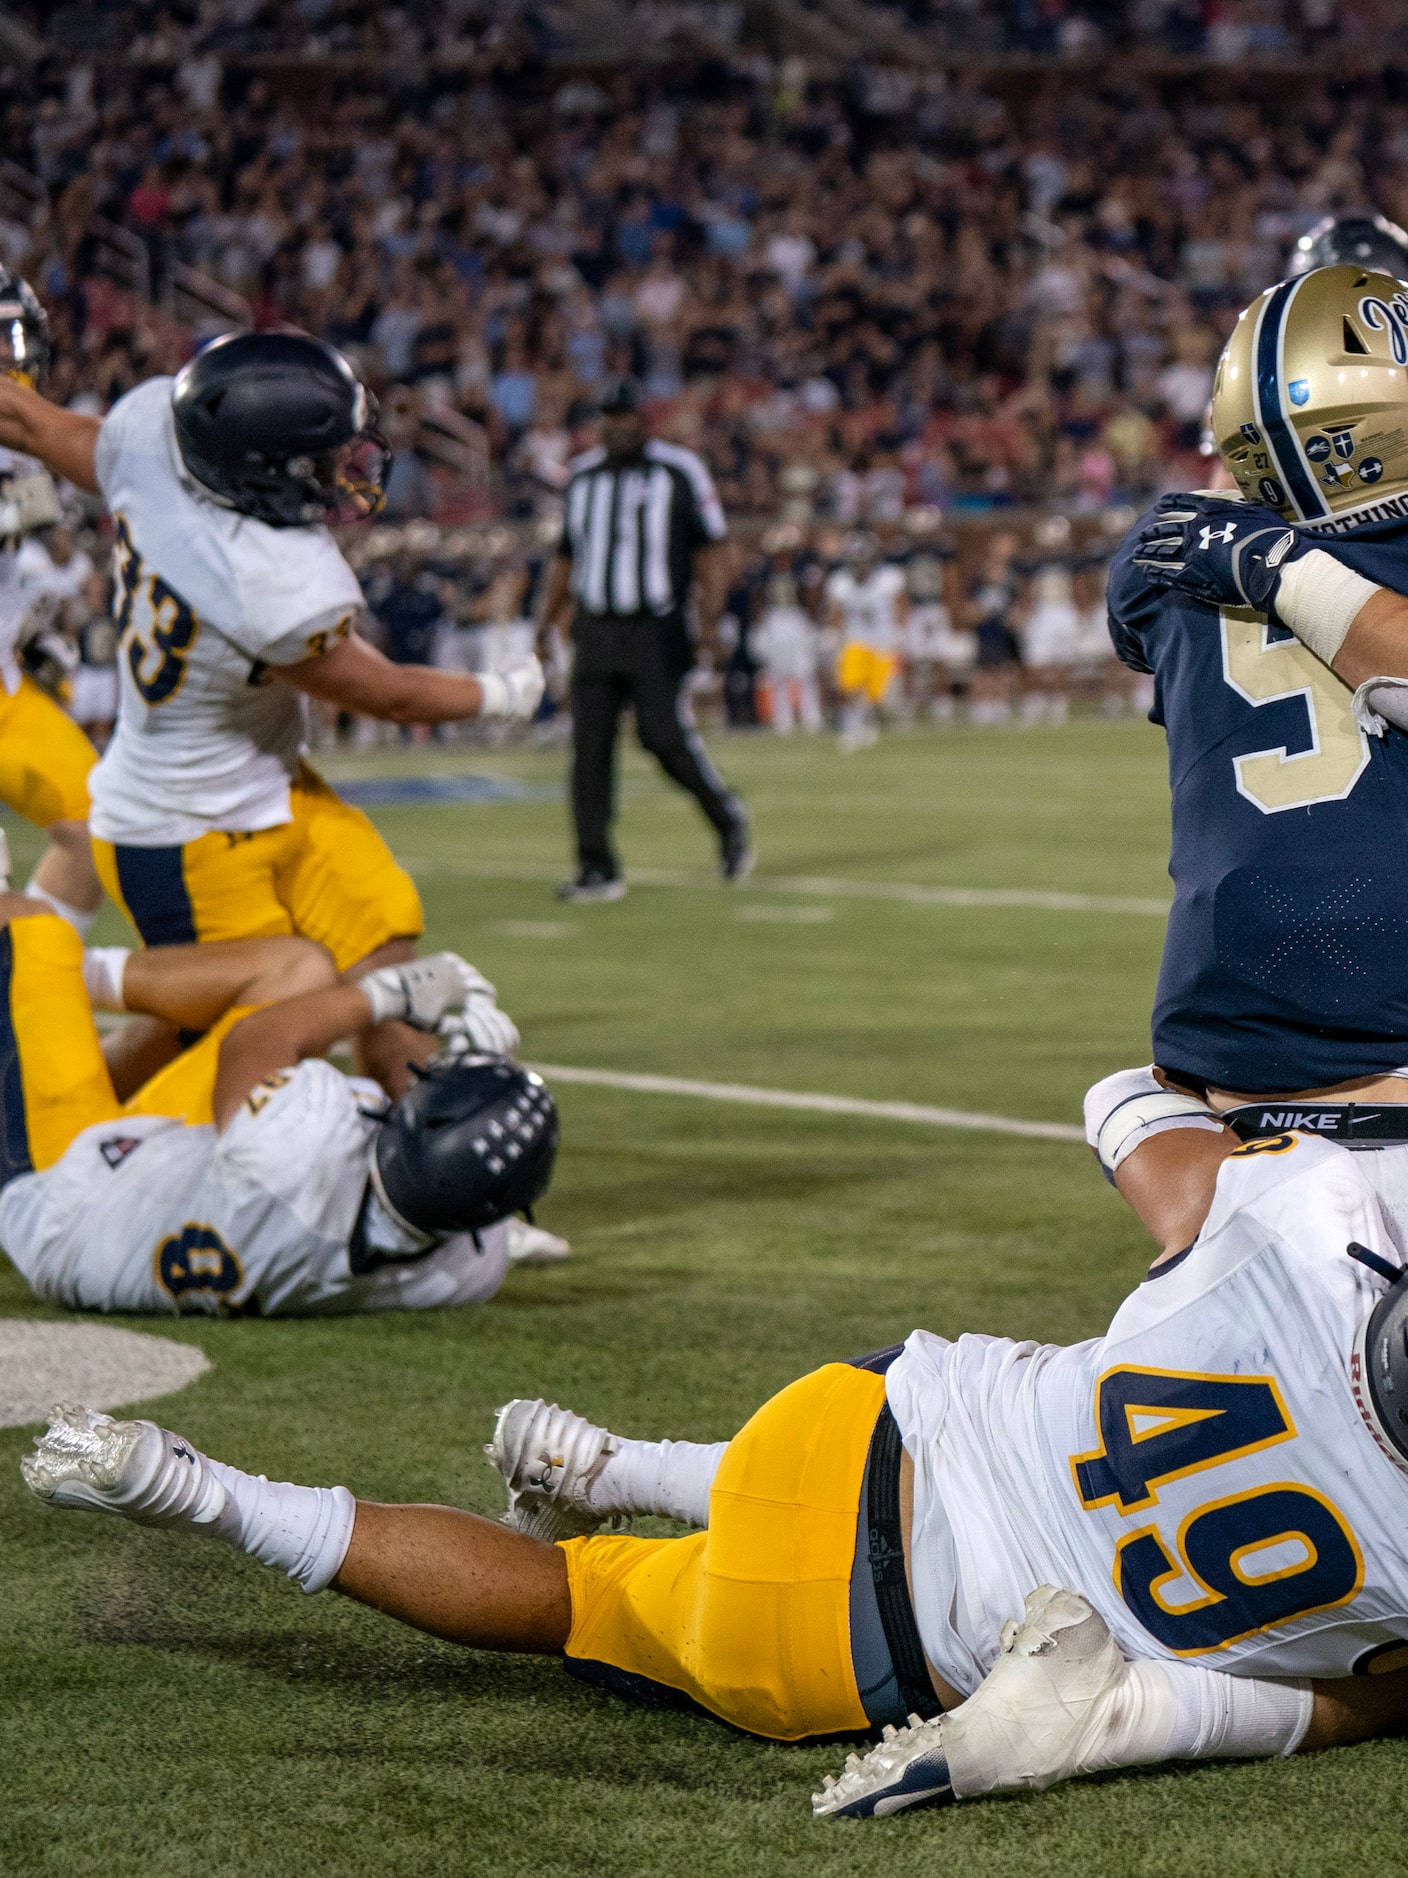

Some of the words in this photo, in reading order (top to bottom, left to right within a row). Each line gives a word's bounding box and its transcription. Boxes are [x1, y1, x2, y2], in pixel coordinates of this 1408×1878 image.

[1253, 452, 1270, 470] 27
[1263, 481, 1280, 503] 9
[1260, 1112, 1342, 1130] NIKE
[1069, 1363, 1366, 1658] 49
